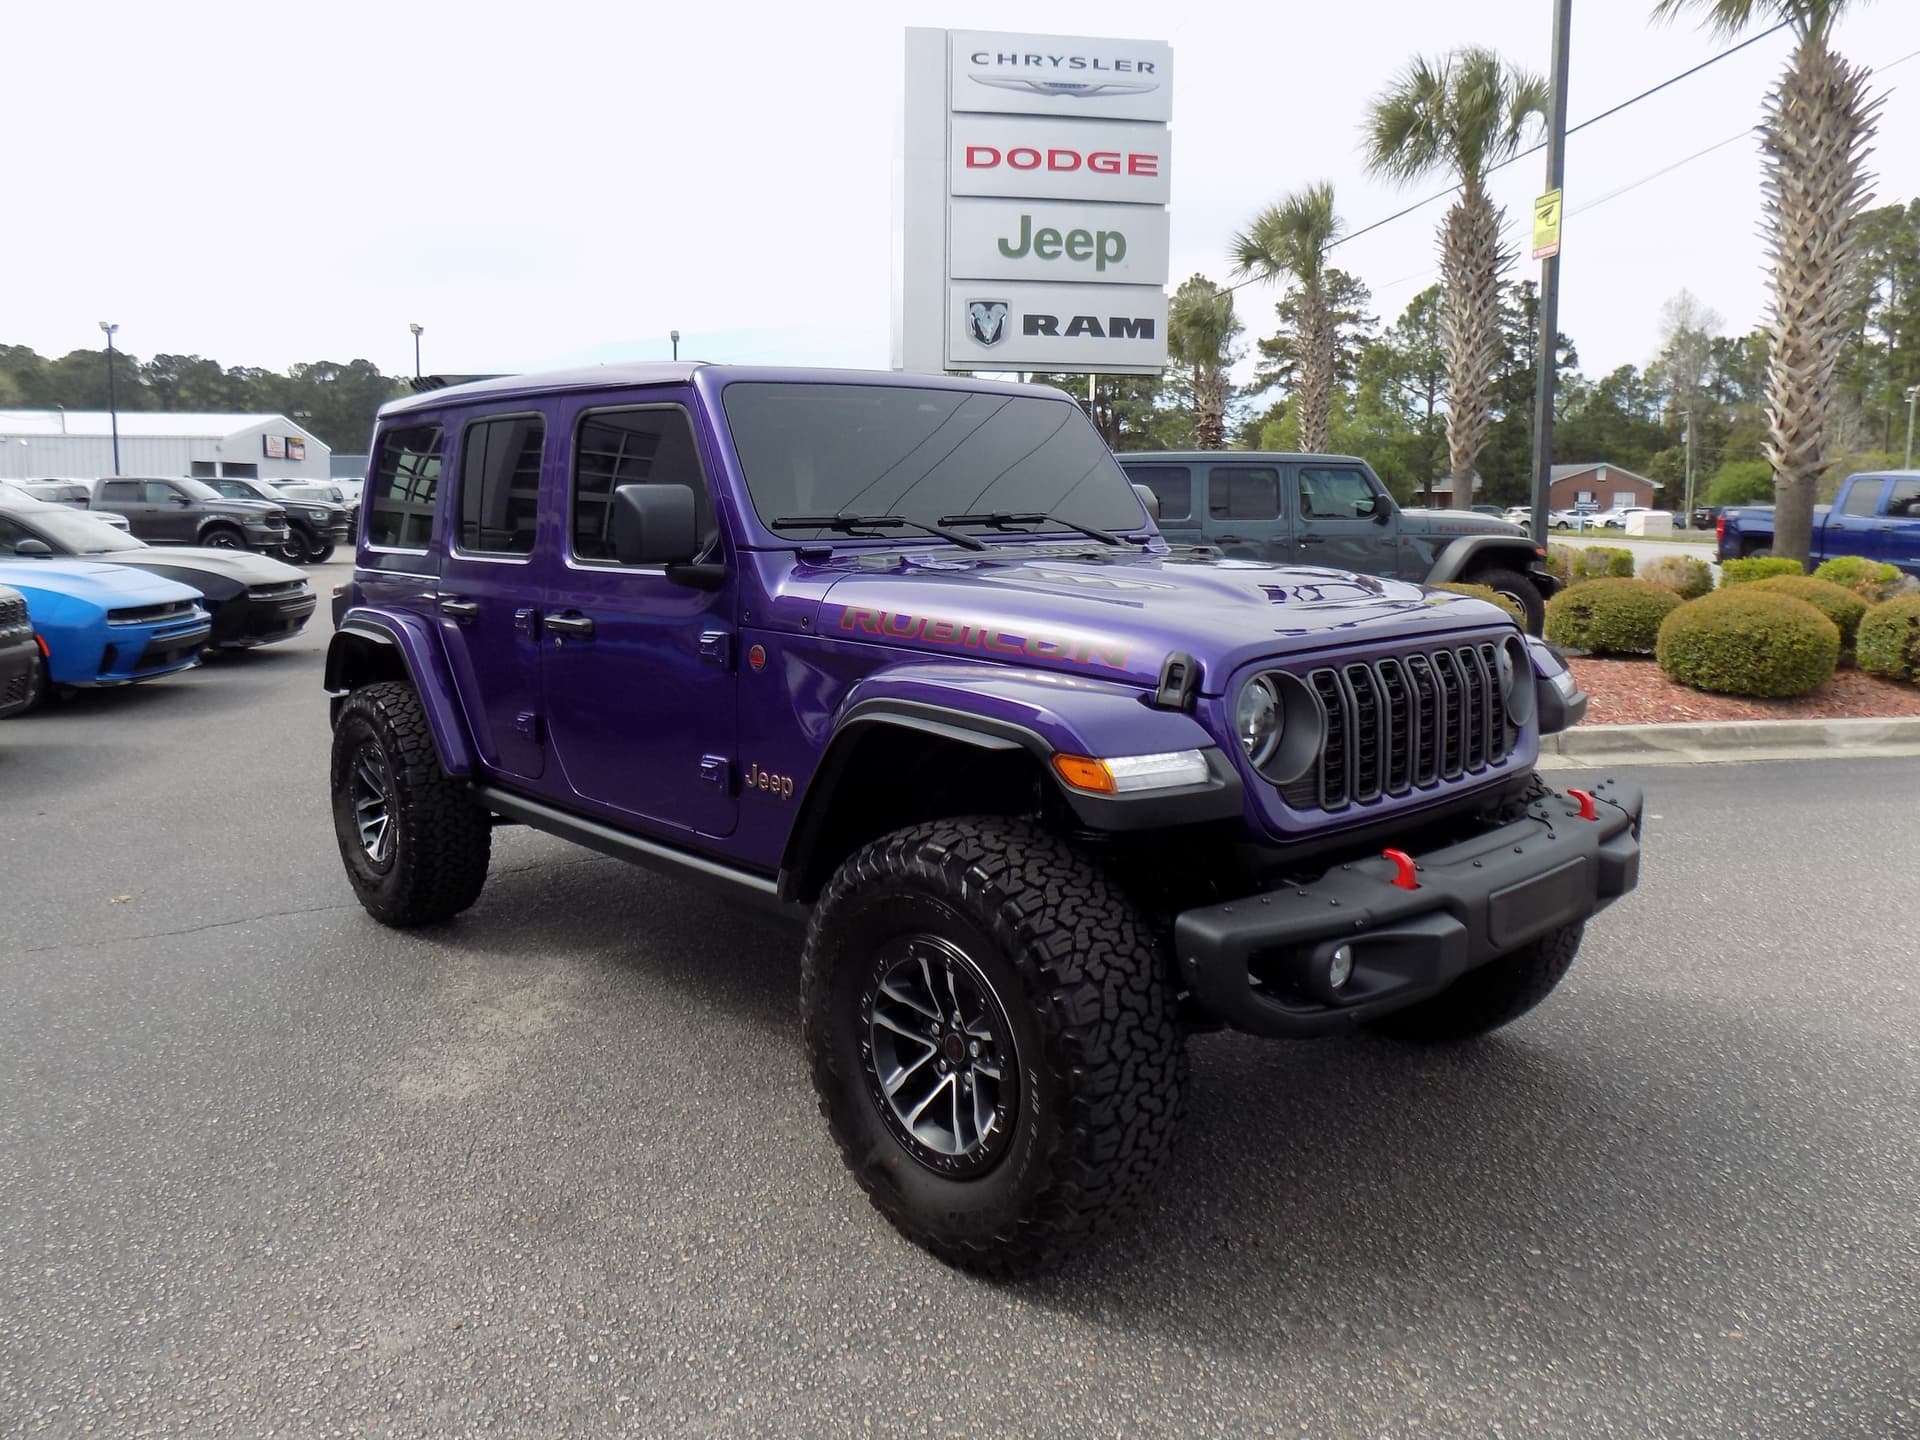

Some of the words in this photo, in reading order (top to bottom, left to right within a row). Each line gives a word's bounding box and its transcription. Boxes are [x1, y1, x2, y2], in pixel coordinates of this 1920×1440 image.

[971, 52, 1155, 74] CHRYSLER
[966, 146, 1159, 177] DODGE
[998, 214, 1127, 271] Jeep
[1023, 314, 1155, 339] RAM
[839, 604, 1129, 670] RUBICON
[745, 763, 794, 801] Jeep
